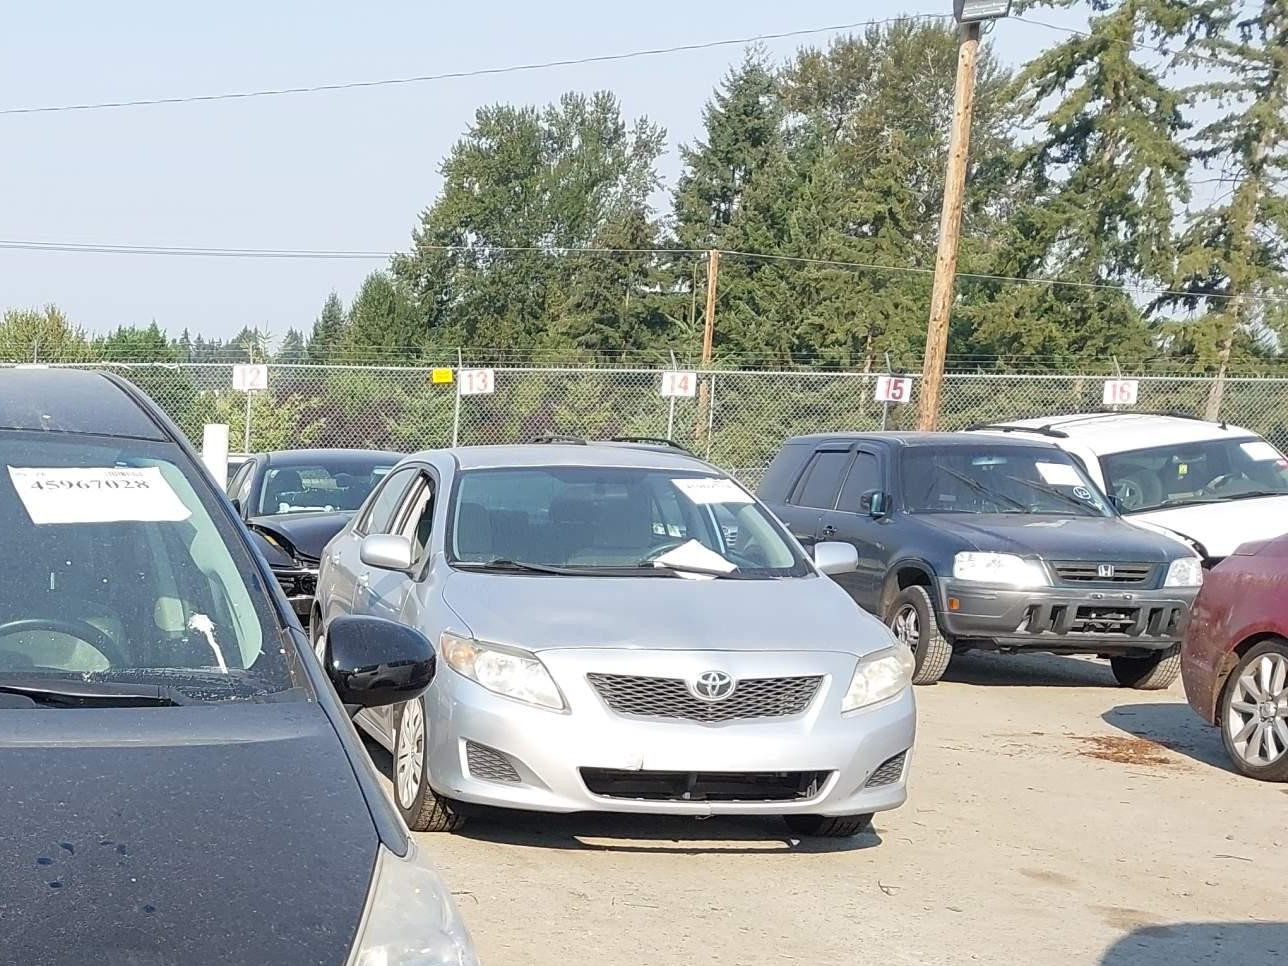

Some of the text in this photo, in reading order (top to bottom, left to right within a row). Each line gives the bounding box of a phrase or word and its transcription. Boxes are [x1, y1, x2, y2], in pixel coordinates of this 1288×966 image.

[240, 367, 261, 388] 12
[467, 371, 489, 392] 13
[669, 374, 689, 394] 14
[884, 378, 905, 400] 15
[1110, 382, 1132, 402] 16
[31, 479, 151, 490] 45967028
